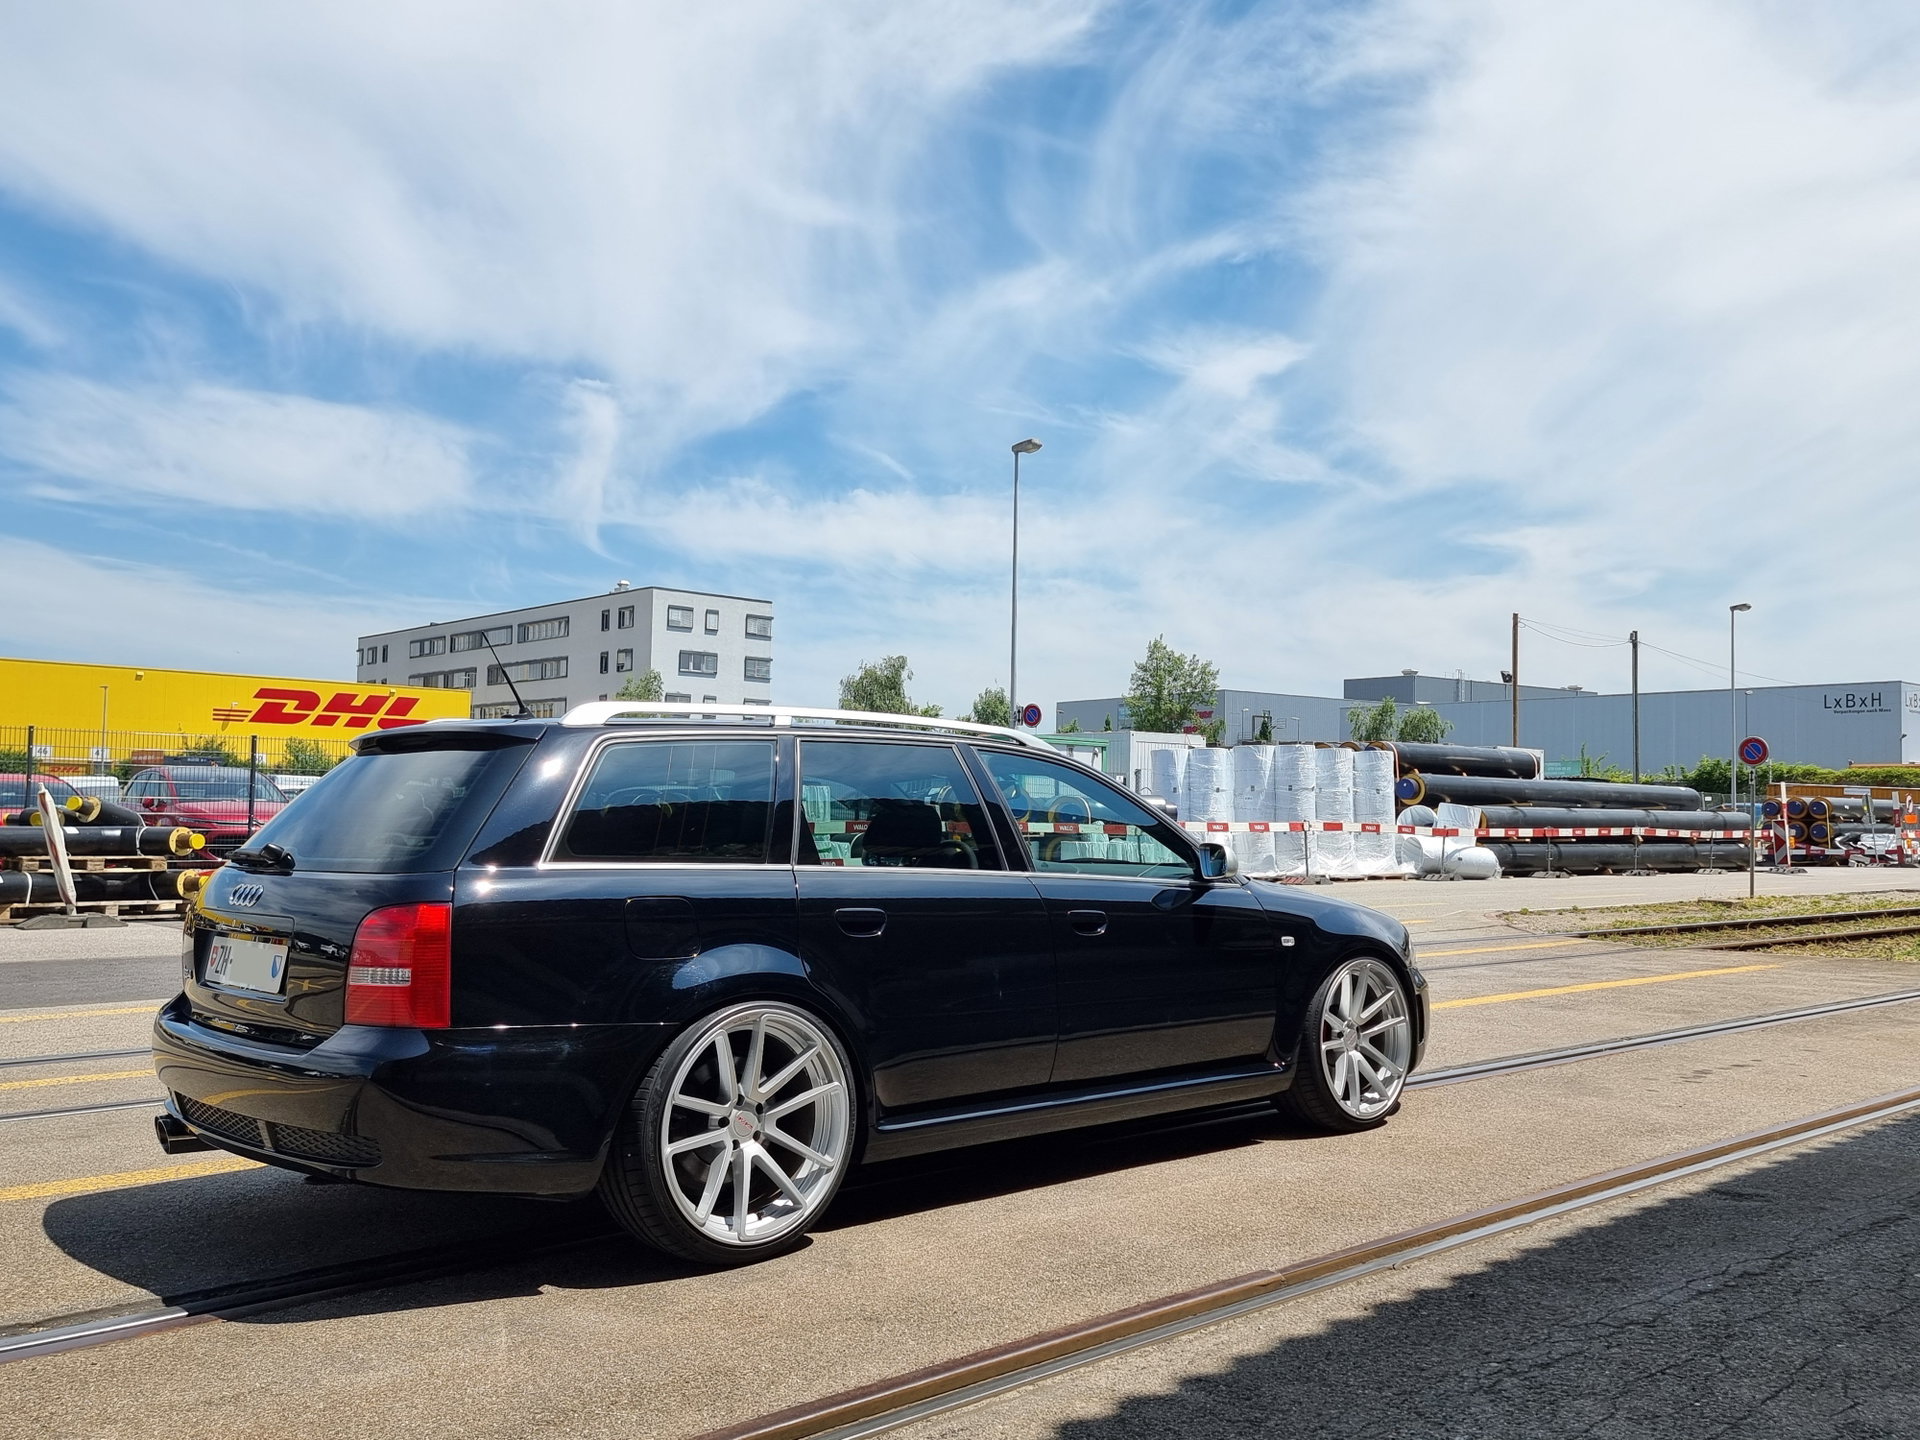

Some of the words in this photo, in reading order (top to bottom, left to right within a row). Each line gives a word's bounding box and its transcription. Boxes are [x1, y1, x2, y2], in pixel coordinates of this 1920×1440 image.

[1824, 692, 1882, 709] LxBxH
[1905, 691, 1920, 708] LxB
[248, 687, 432, 730] DHL
